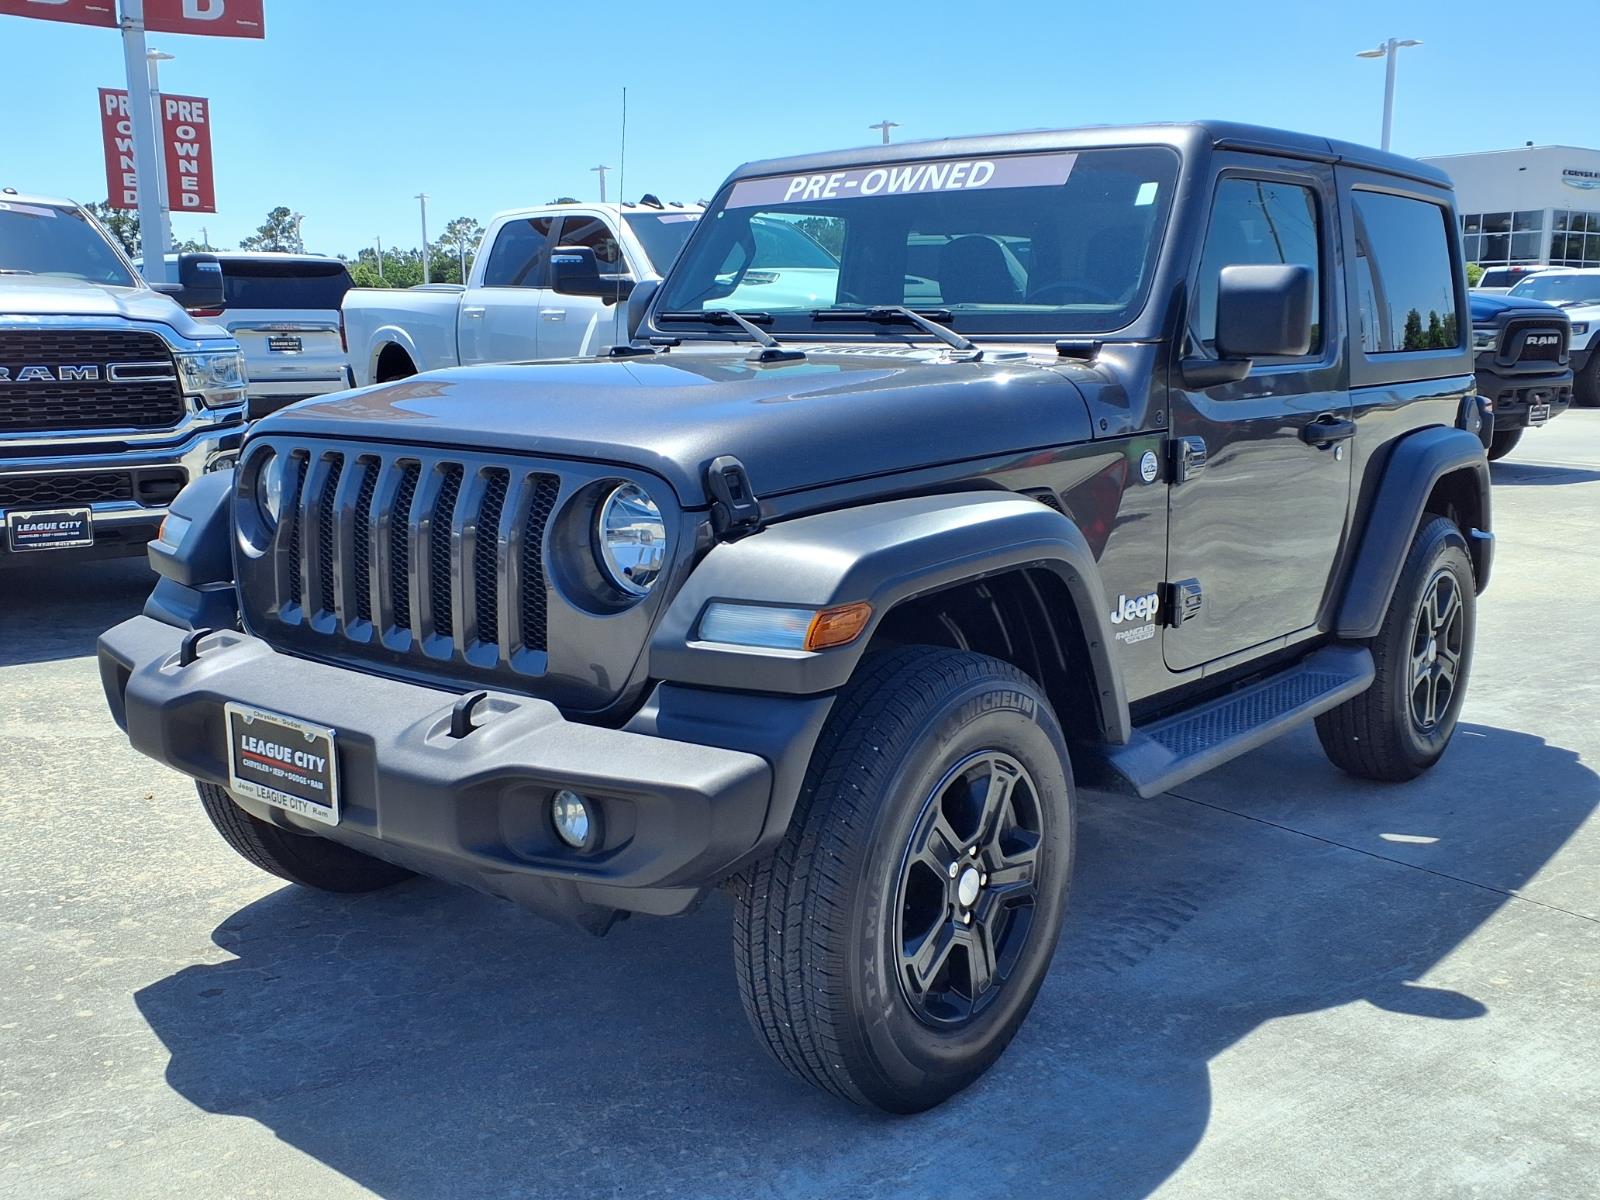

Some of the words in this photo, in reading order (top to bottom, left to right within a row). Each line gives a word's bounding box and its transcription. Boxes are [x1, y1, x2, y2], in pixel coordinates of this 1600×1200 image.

[105, 94, 131, 117] PR
[165, 99, 204, 123] PRE
[174, 125, 200, 207] OWNED
[783, 161, 996, 202] PRE-OWNED
[1526, 336, 1558, 345] RAM
[17, 522, 57, 532] LEAGUE
[58, 520, 82, 529] CITY
[1110, 593, 1159, 624] Jeep
[960, 690, 1034, 723] MICHELIN
[241, 735, 292, 764] LEAGUE
[294, 751, 325, 773] CITY
[243, 758, 270, 773] CHRYSLER
[272, 767, 285, 778] JEEP
[288, 772, 308, 785] DODGE
[310, 778, 324, 790] RAM
[256, 786, 288, 806] LEAGUE
[289, 797, 308, 813] CITY
[312, 806, 328, 818] Ram
